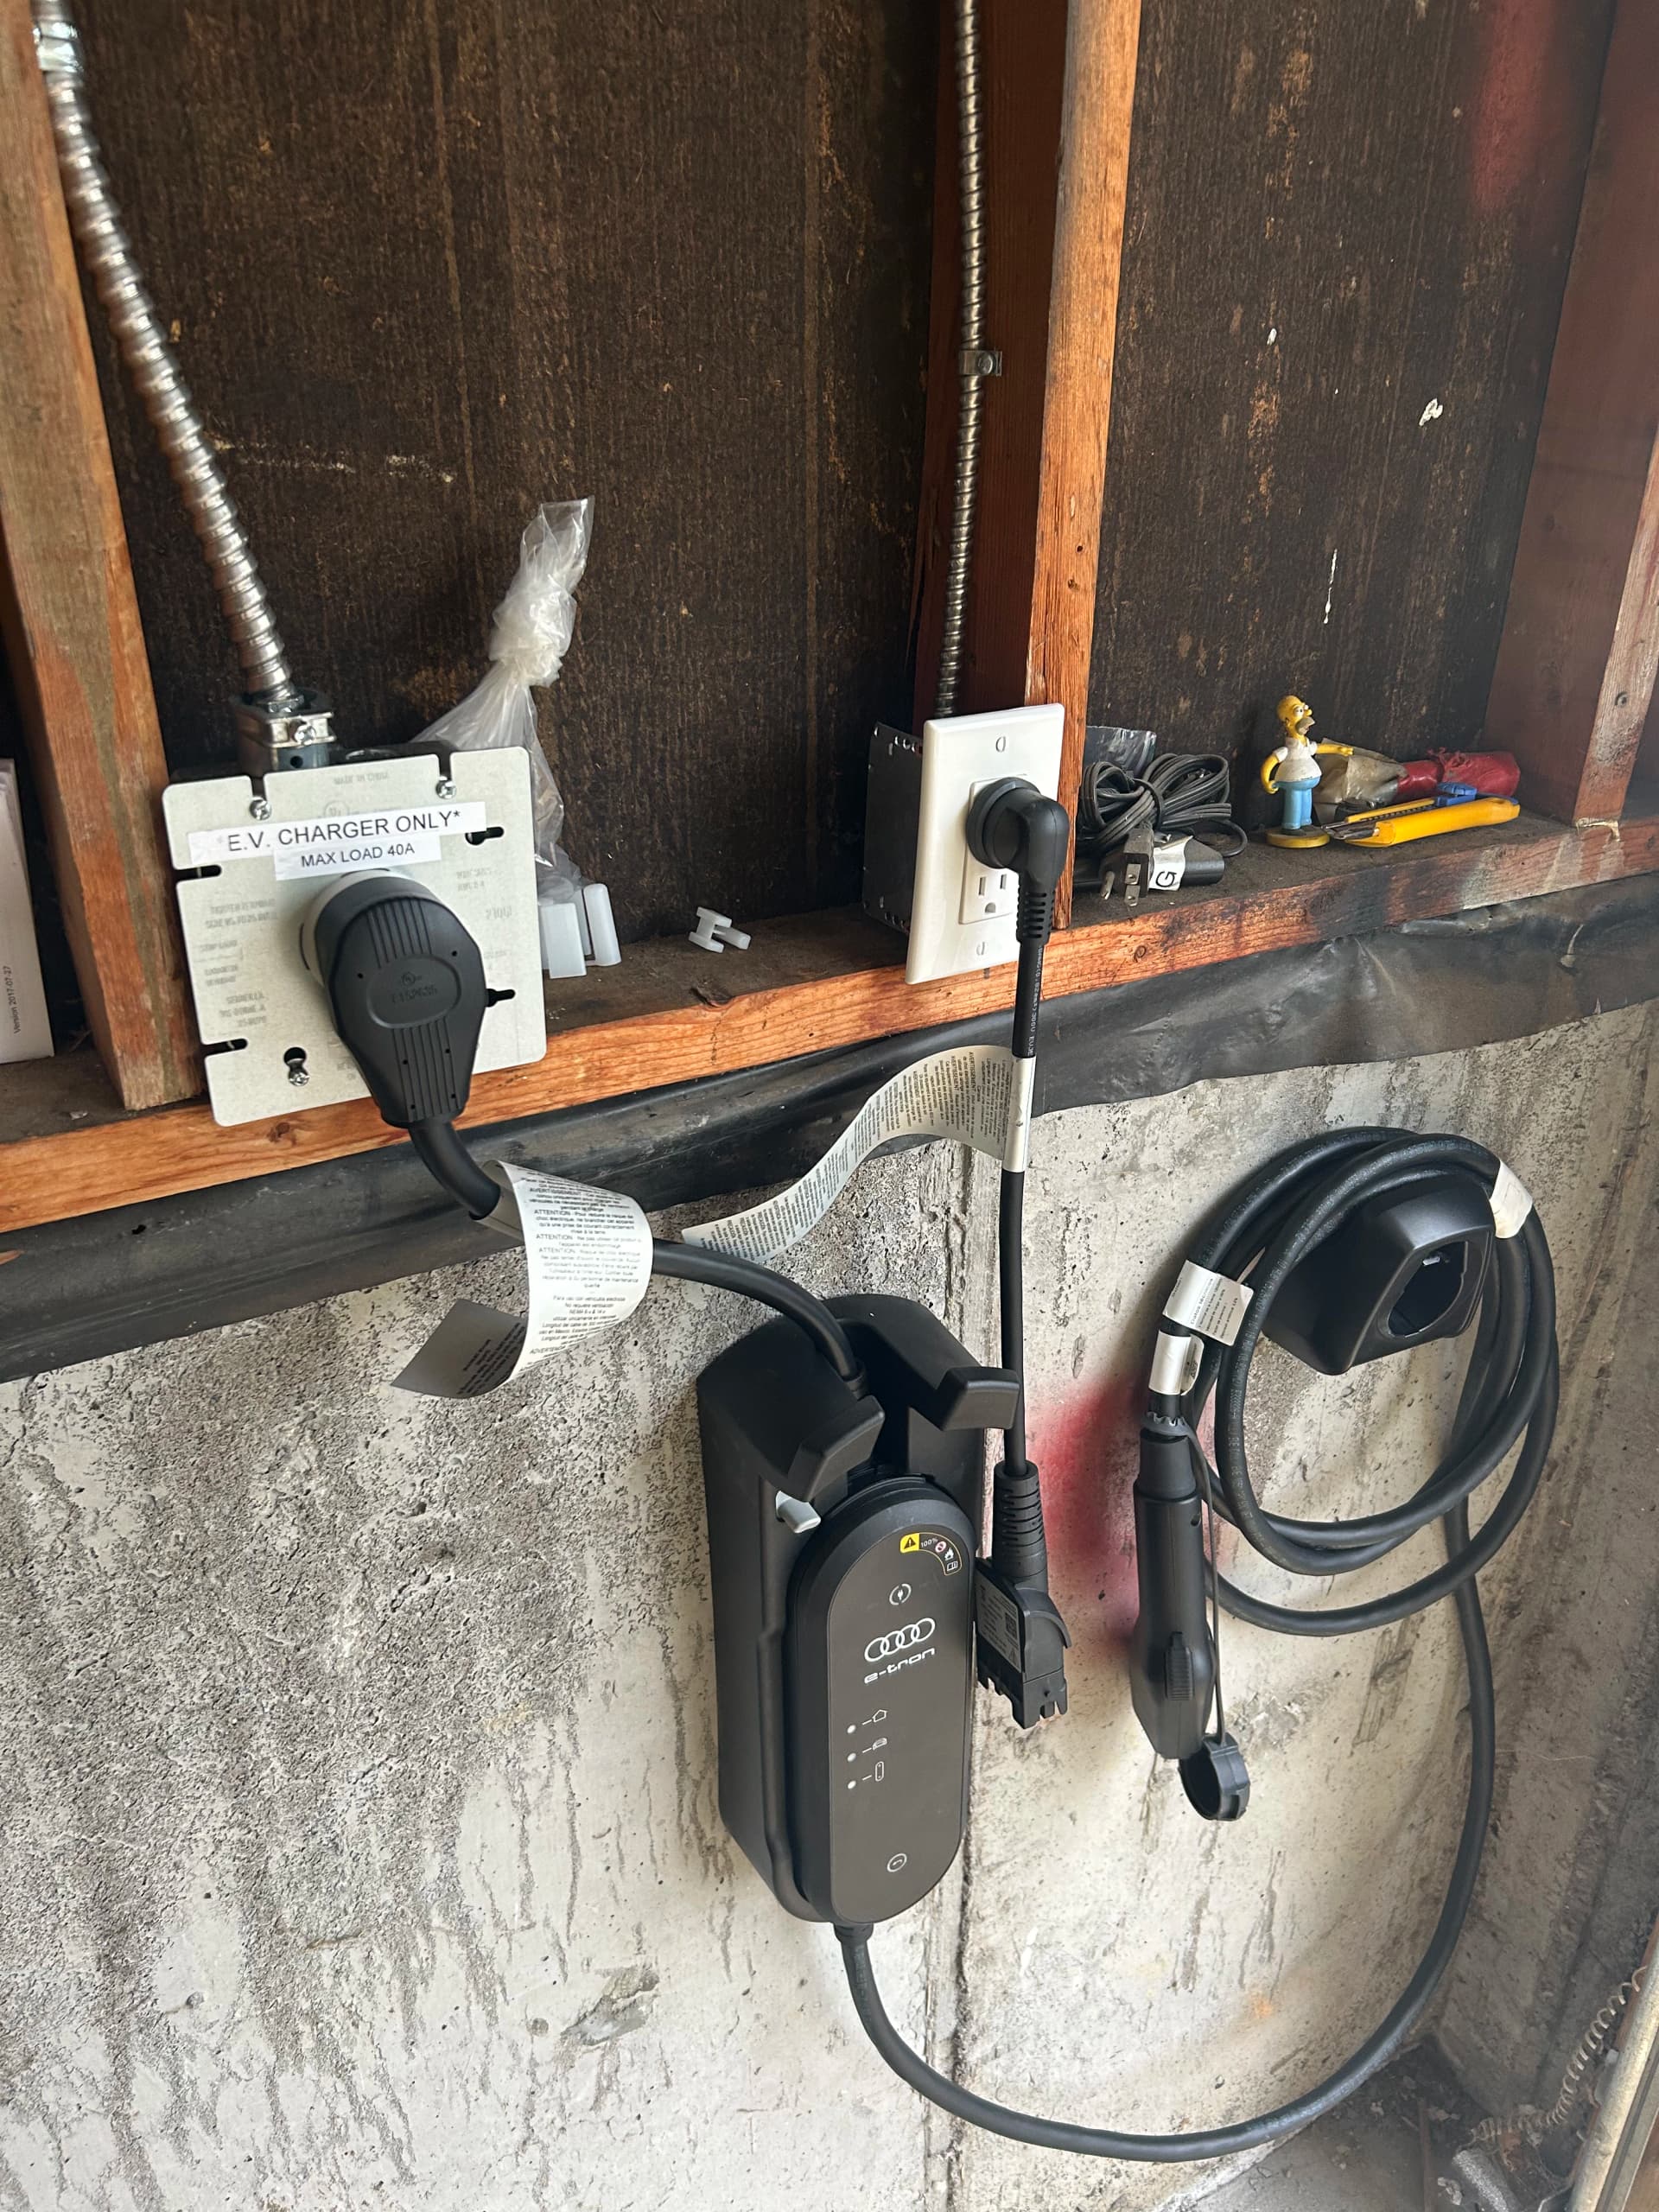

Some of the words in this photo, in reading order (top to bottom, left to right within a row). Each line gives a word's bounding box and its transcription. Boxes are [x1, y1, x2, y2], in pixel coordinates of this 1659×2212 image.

[228, 831, 270, 851] E.V.
[278, 817, 390, 845] CHARGER
[301, 853, 337, 868] MAX
[340, 846, 384, 864] LOAD
[387, 844, 416, 858] 40A
[1155, 871, 1177, 887] G
[12, 1007, 21, 1033] Version
[920, 1537, 939, 1548] 100%
[864, 1648, 935, 1684] e-tron
